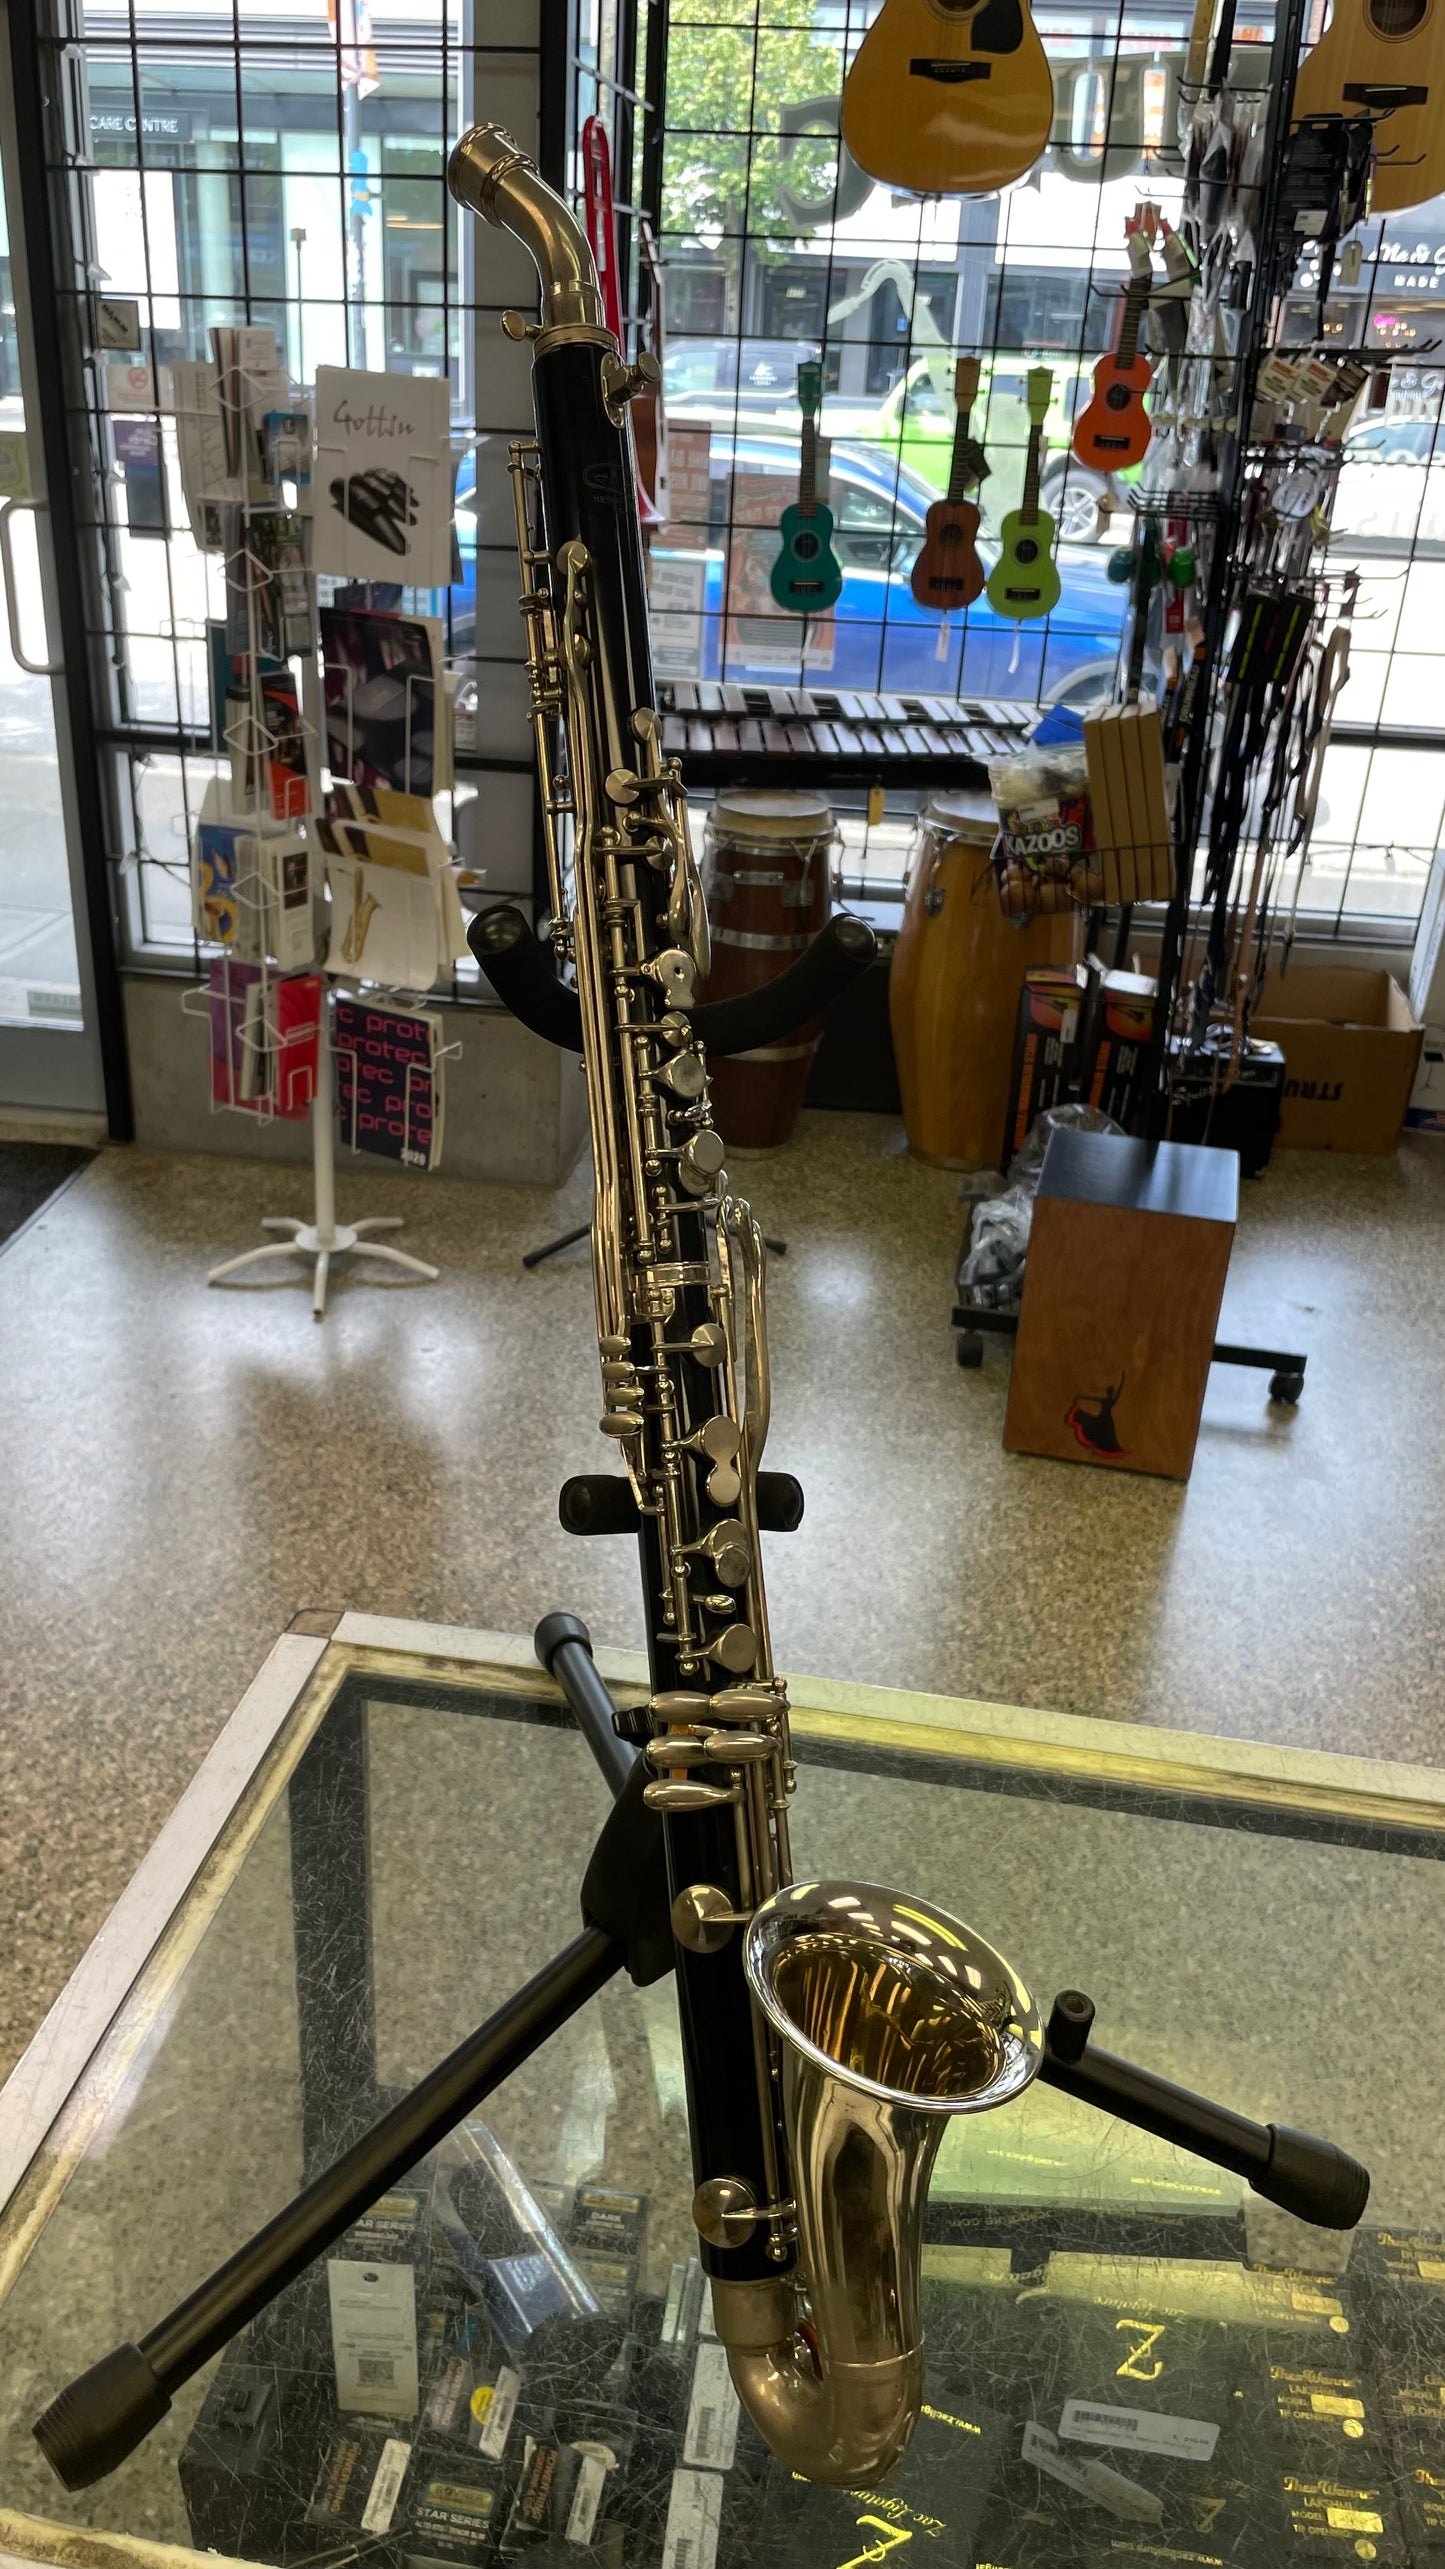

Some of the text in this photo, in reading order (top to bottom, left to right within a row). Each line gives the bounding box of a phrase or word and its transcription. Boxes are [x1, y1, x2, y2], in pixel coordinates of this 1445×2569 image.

[88, 115, 178, 133] CARE CNTRE
[1004, 823, 1080, 857] KAZOOS
[365, 1014, 431, 1043] prot
[416, 2506, 490, 2530] STAR SERIES
[912, 2511, 948, 2538] Zac
